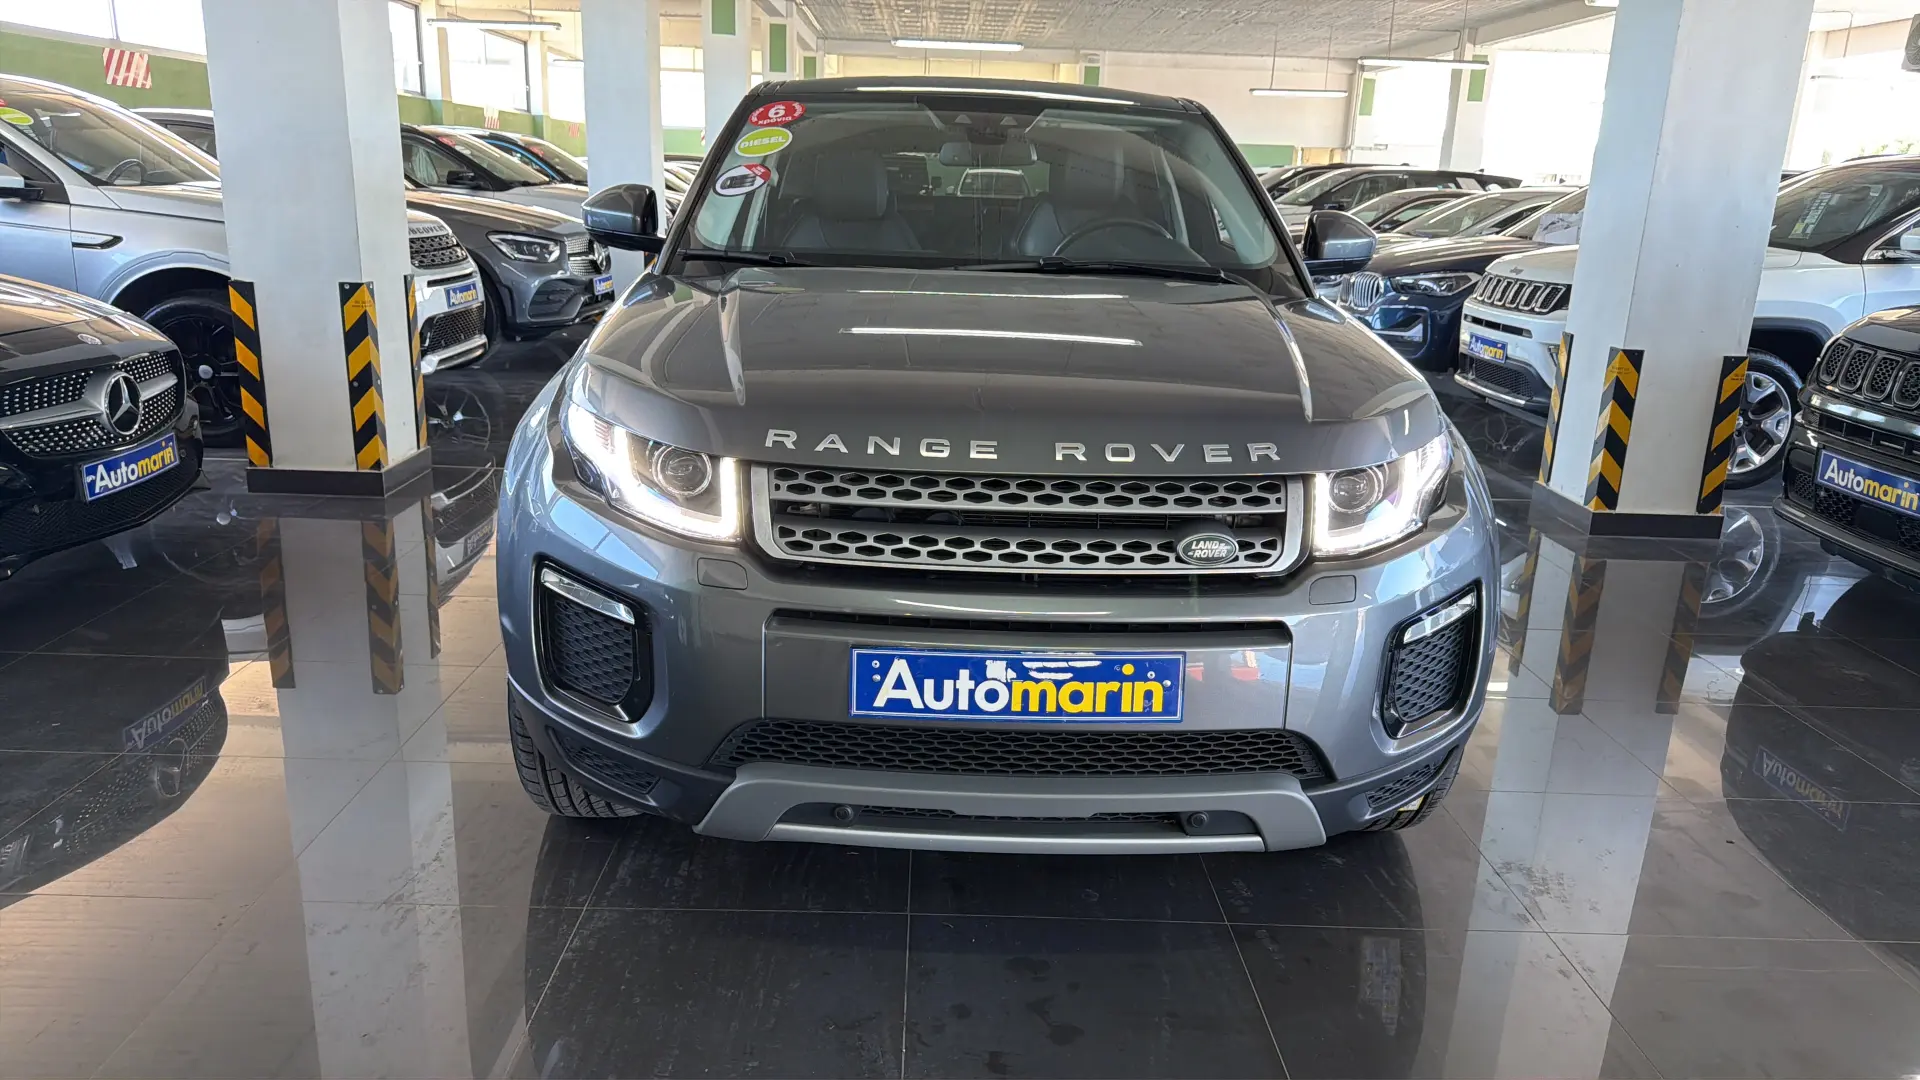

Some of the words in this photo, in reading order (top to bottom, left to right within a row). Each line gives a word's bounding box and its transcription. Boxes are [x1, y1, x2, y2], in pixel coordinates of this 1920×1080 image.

[768, 105, 786, 118] 6
[758, 115, 792, 125] χρόνια
[740, 136, 787, 148] DIESEL
[765, 429, 998, 459] RANGE
[1055, 442, 1281, 463] ROVER
[95, 440, 175, 494] Automarin
[1823, 458, 1919, 511] Automarin
[1191, 541, 1220, 550] LAND
[1193, 549, 1228, 558] ROVER
[872, 656, 1163, 713] Automarin
